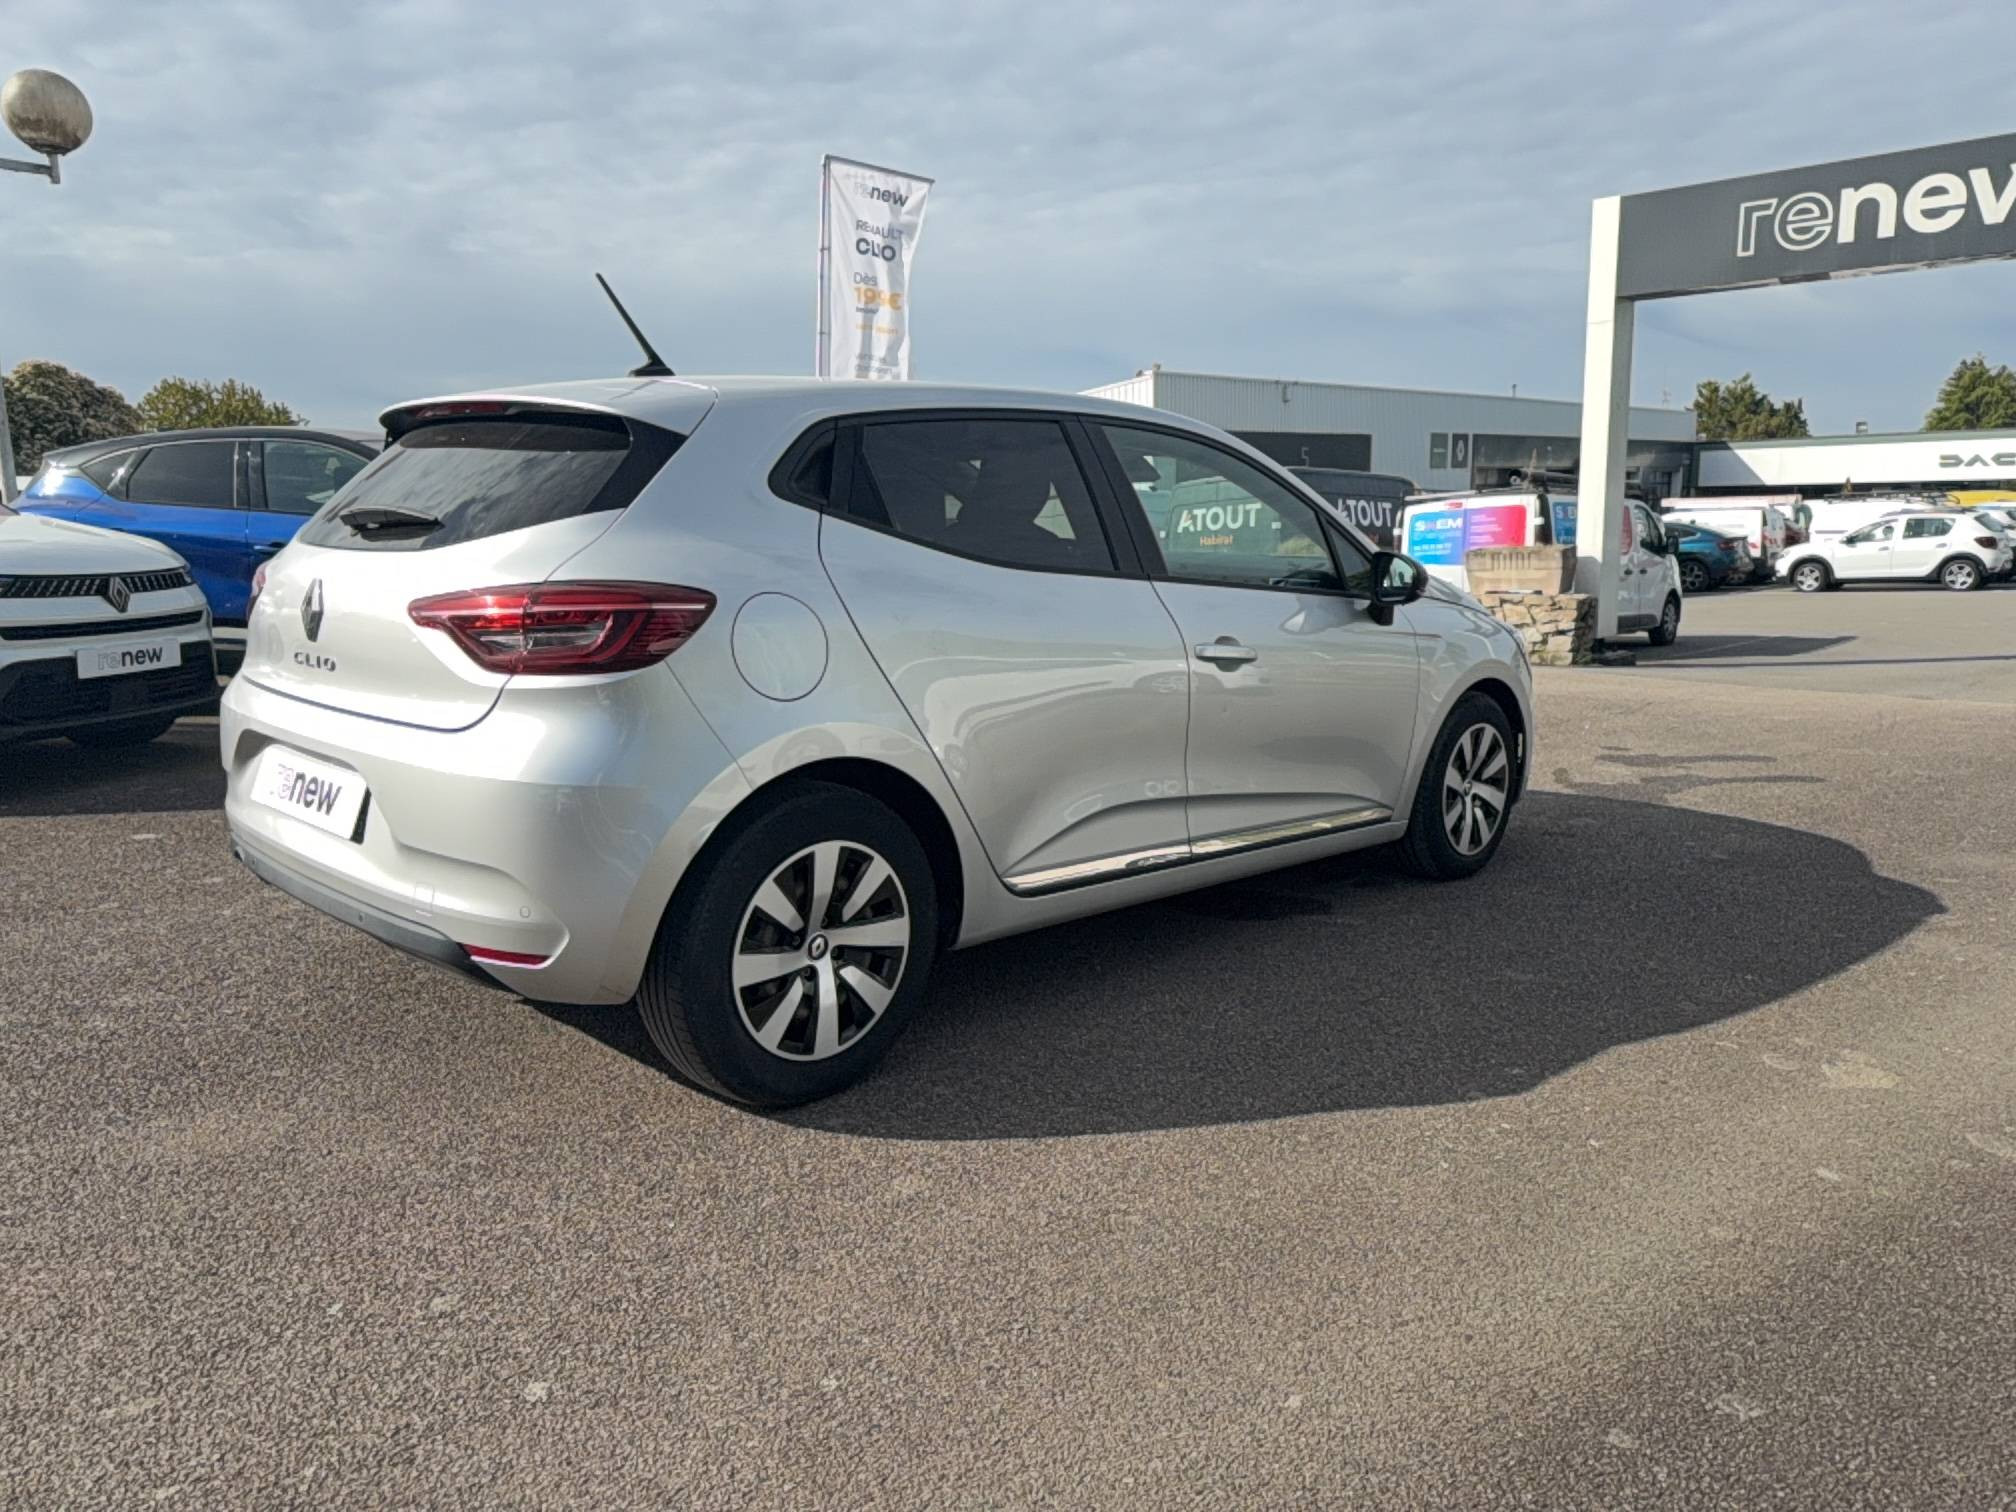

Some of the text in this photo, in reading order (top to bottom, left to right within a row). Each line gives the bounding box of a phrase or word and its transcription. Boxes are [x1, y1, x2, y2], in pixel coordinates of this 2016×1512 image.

[1177, 503, 1262, 533] ATOUT
[97, 647, 163, 670] renew
[294, 652, 337, 672] CLIO
